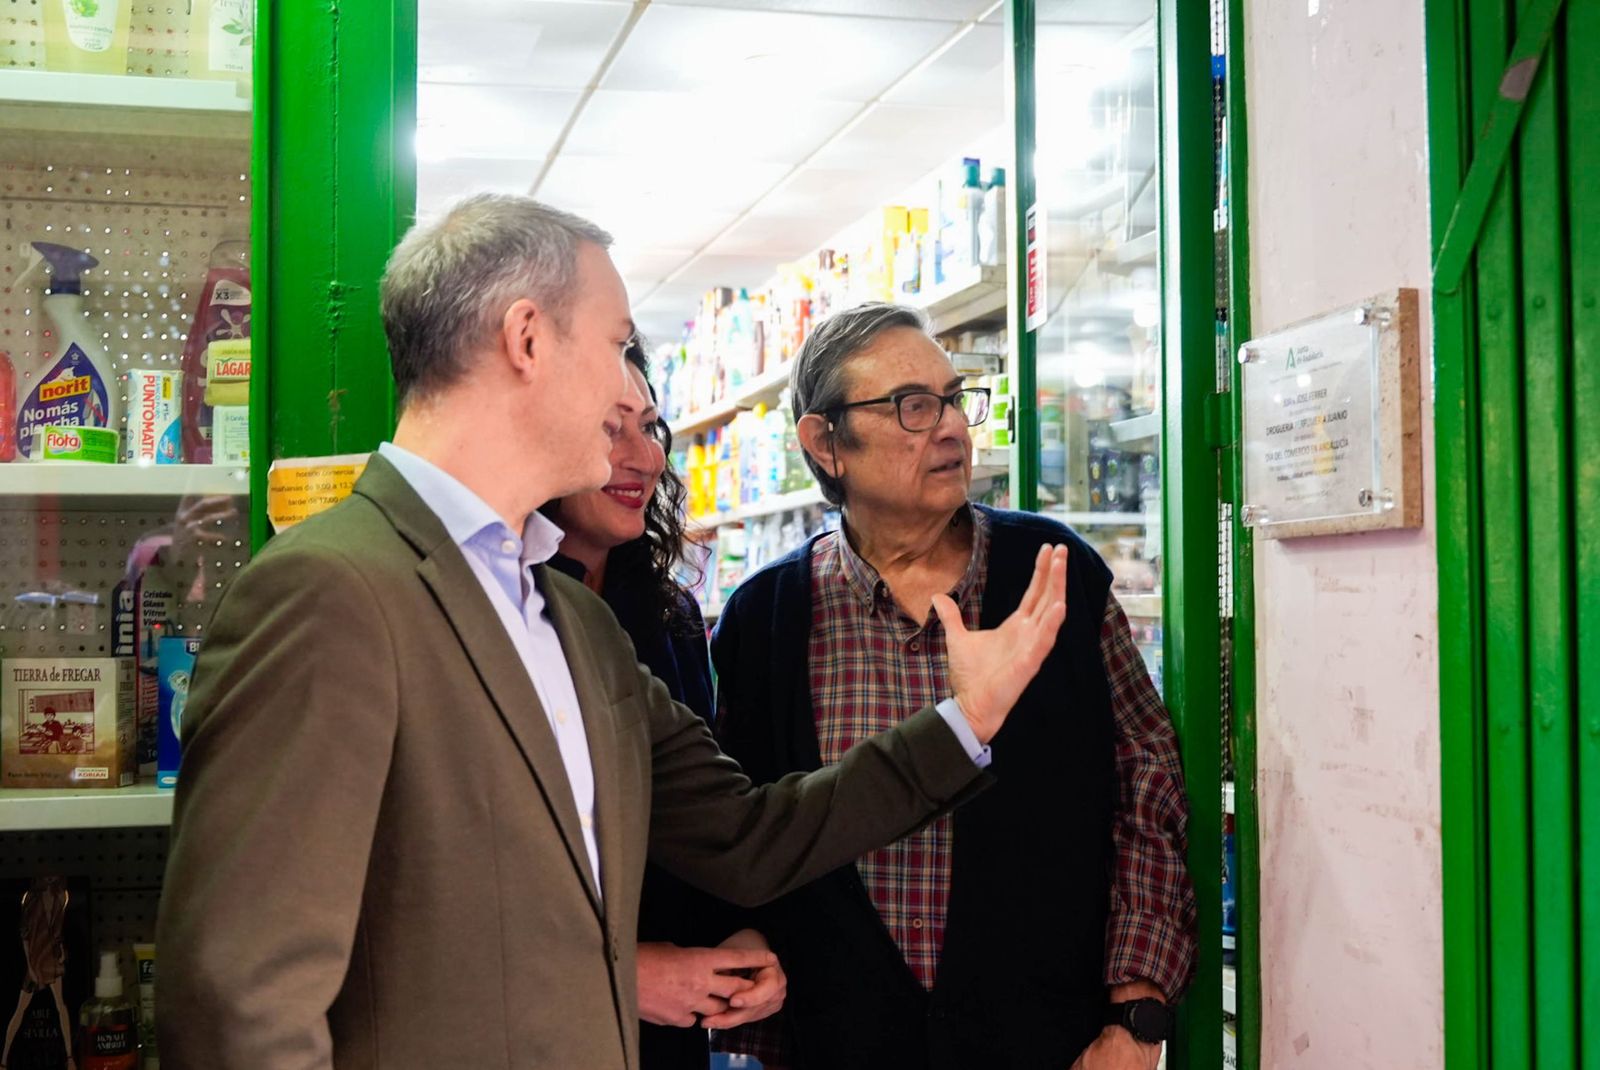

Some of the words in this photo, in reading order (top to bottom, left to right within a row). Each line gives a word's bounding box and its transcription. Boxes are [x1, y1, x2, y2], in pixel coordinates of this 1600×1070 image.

[215, 291, 230, 300] X3
[42, 378, 89, 399] norit
[24, 408, 45, 423] No
[47, 401, 79, 418] más
[142, 375, 156, 459] PUNTOMATIC
[47, 433, 79, 448] Flota
[143, 600, 165, 608] Glass
[13, 668, 48, 682] TIERRA
[49, 666, 61, 682] de
[62, 668, 102, 682] FREGAR
